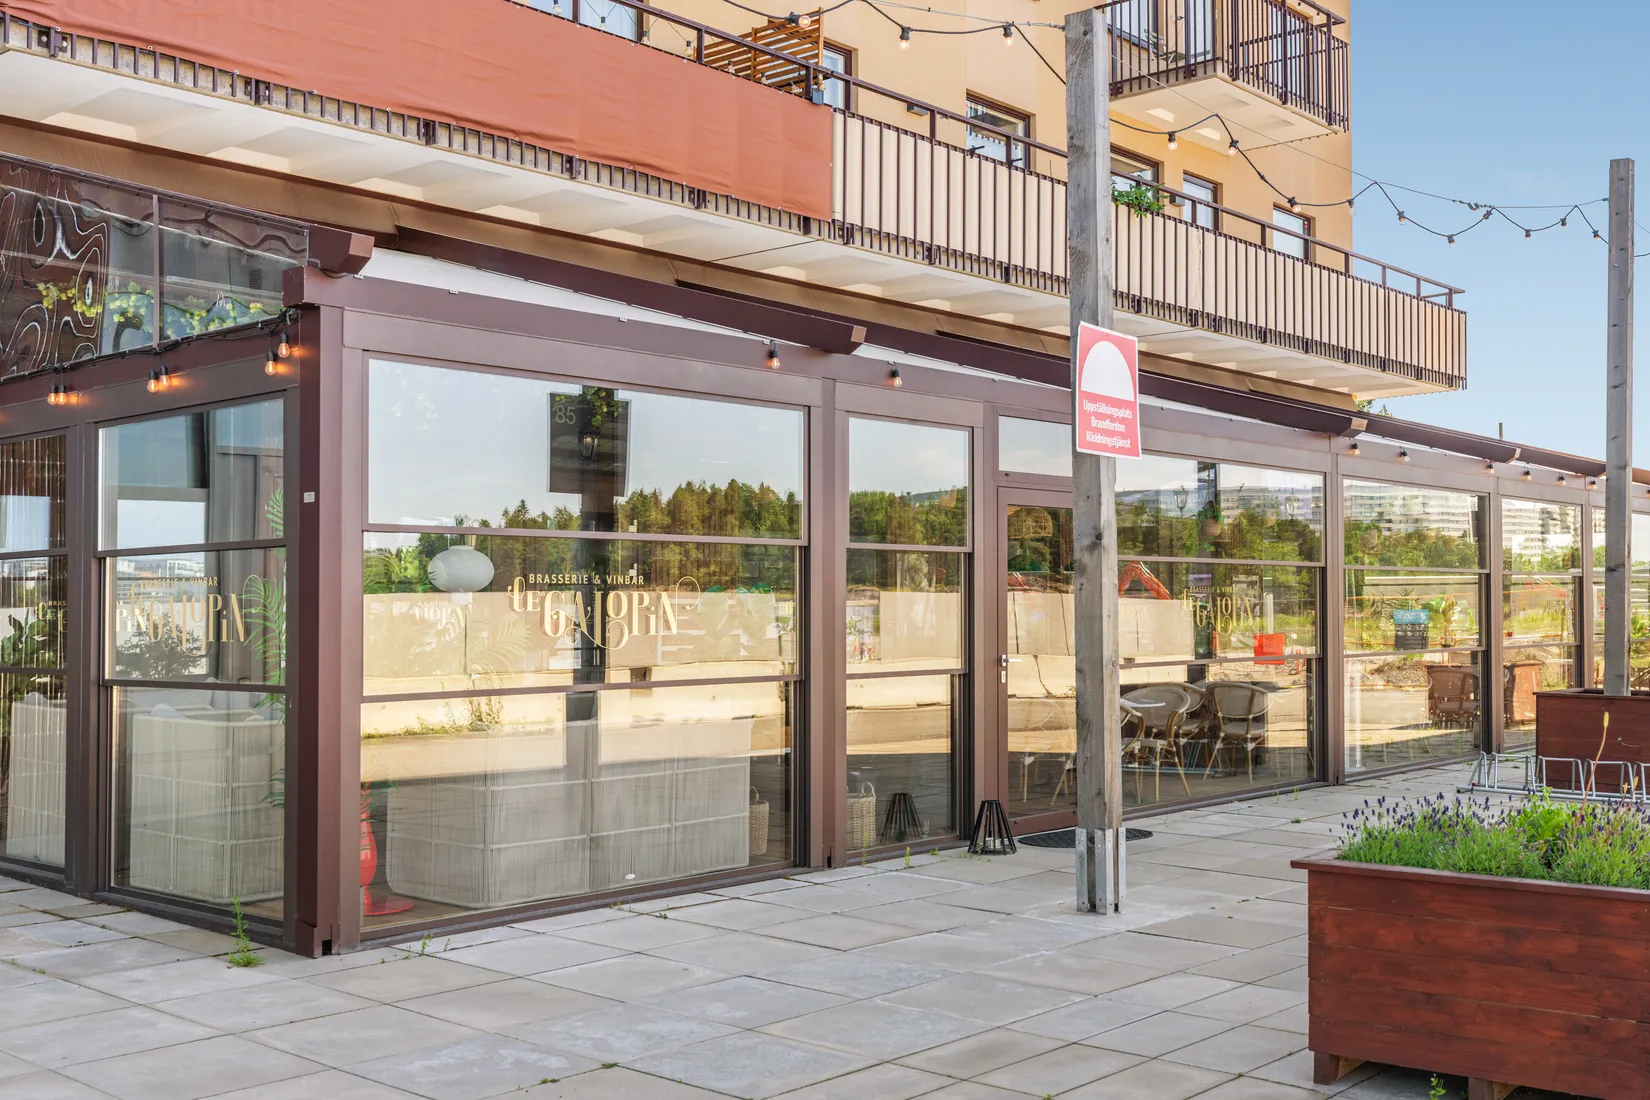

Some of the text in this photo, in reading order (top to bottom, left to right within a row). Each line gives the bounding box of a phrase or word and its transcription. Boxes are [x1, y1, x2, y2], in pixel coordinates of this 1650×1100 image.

[555, 405, 576, 425] 85
[1083, 399, 1132, 419] Uppställningsplats
[1091, 416, 1125, 432] Brandfordon
[1086, 430, 1131, 448] Räddningstjänst
[529, 573, 645, 586] BRASSERIE & VINBAR
